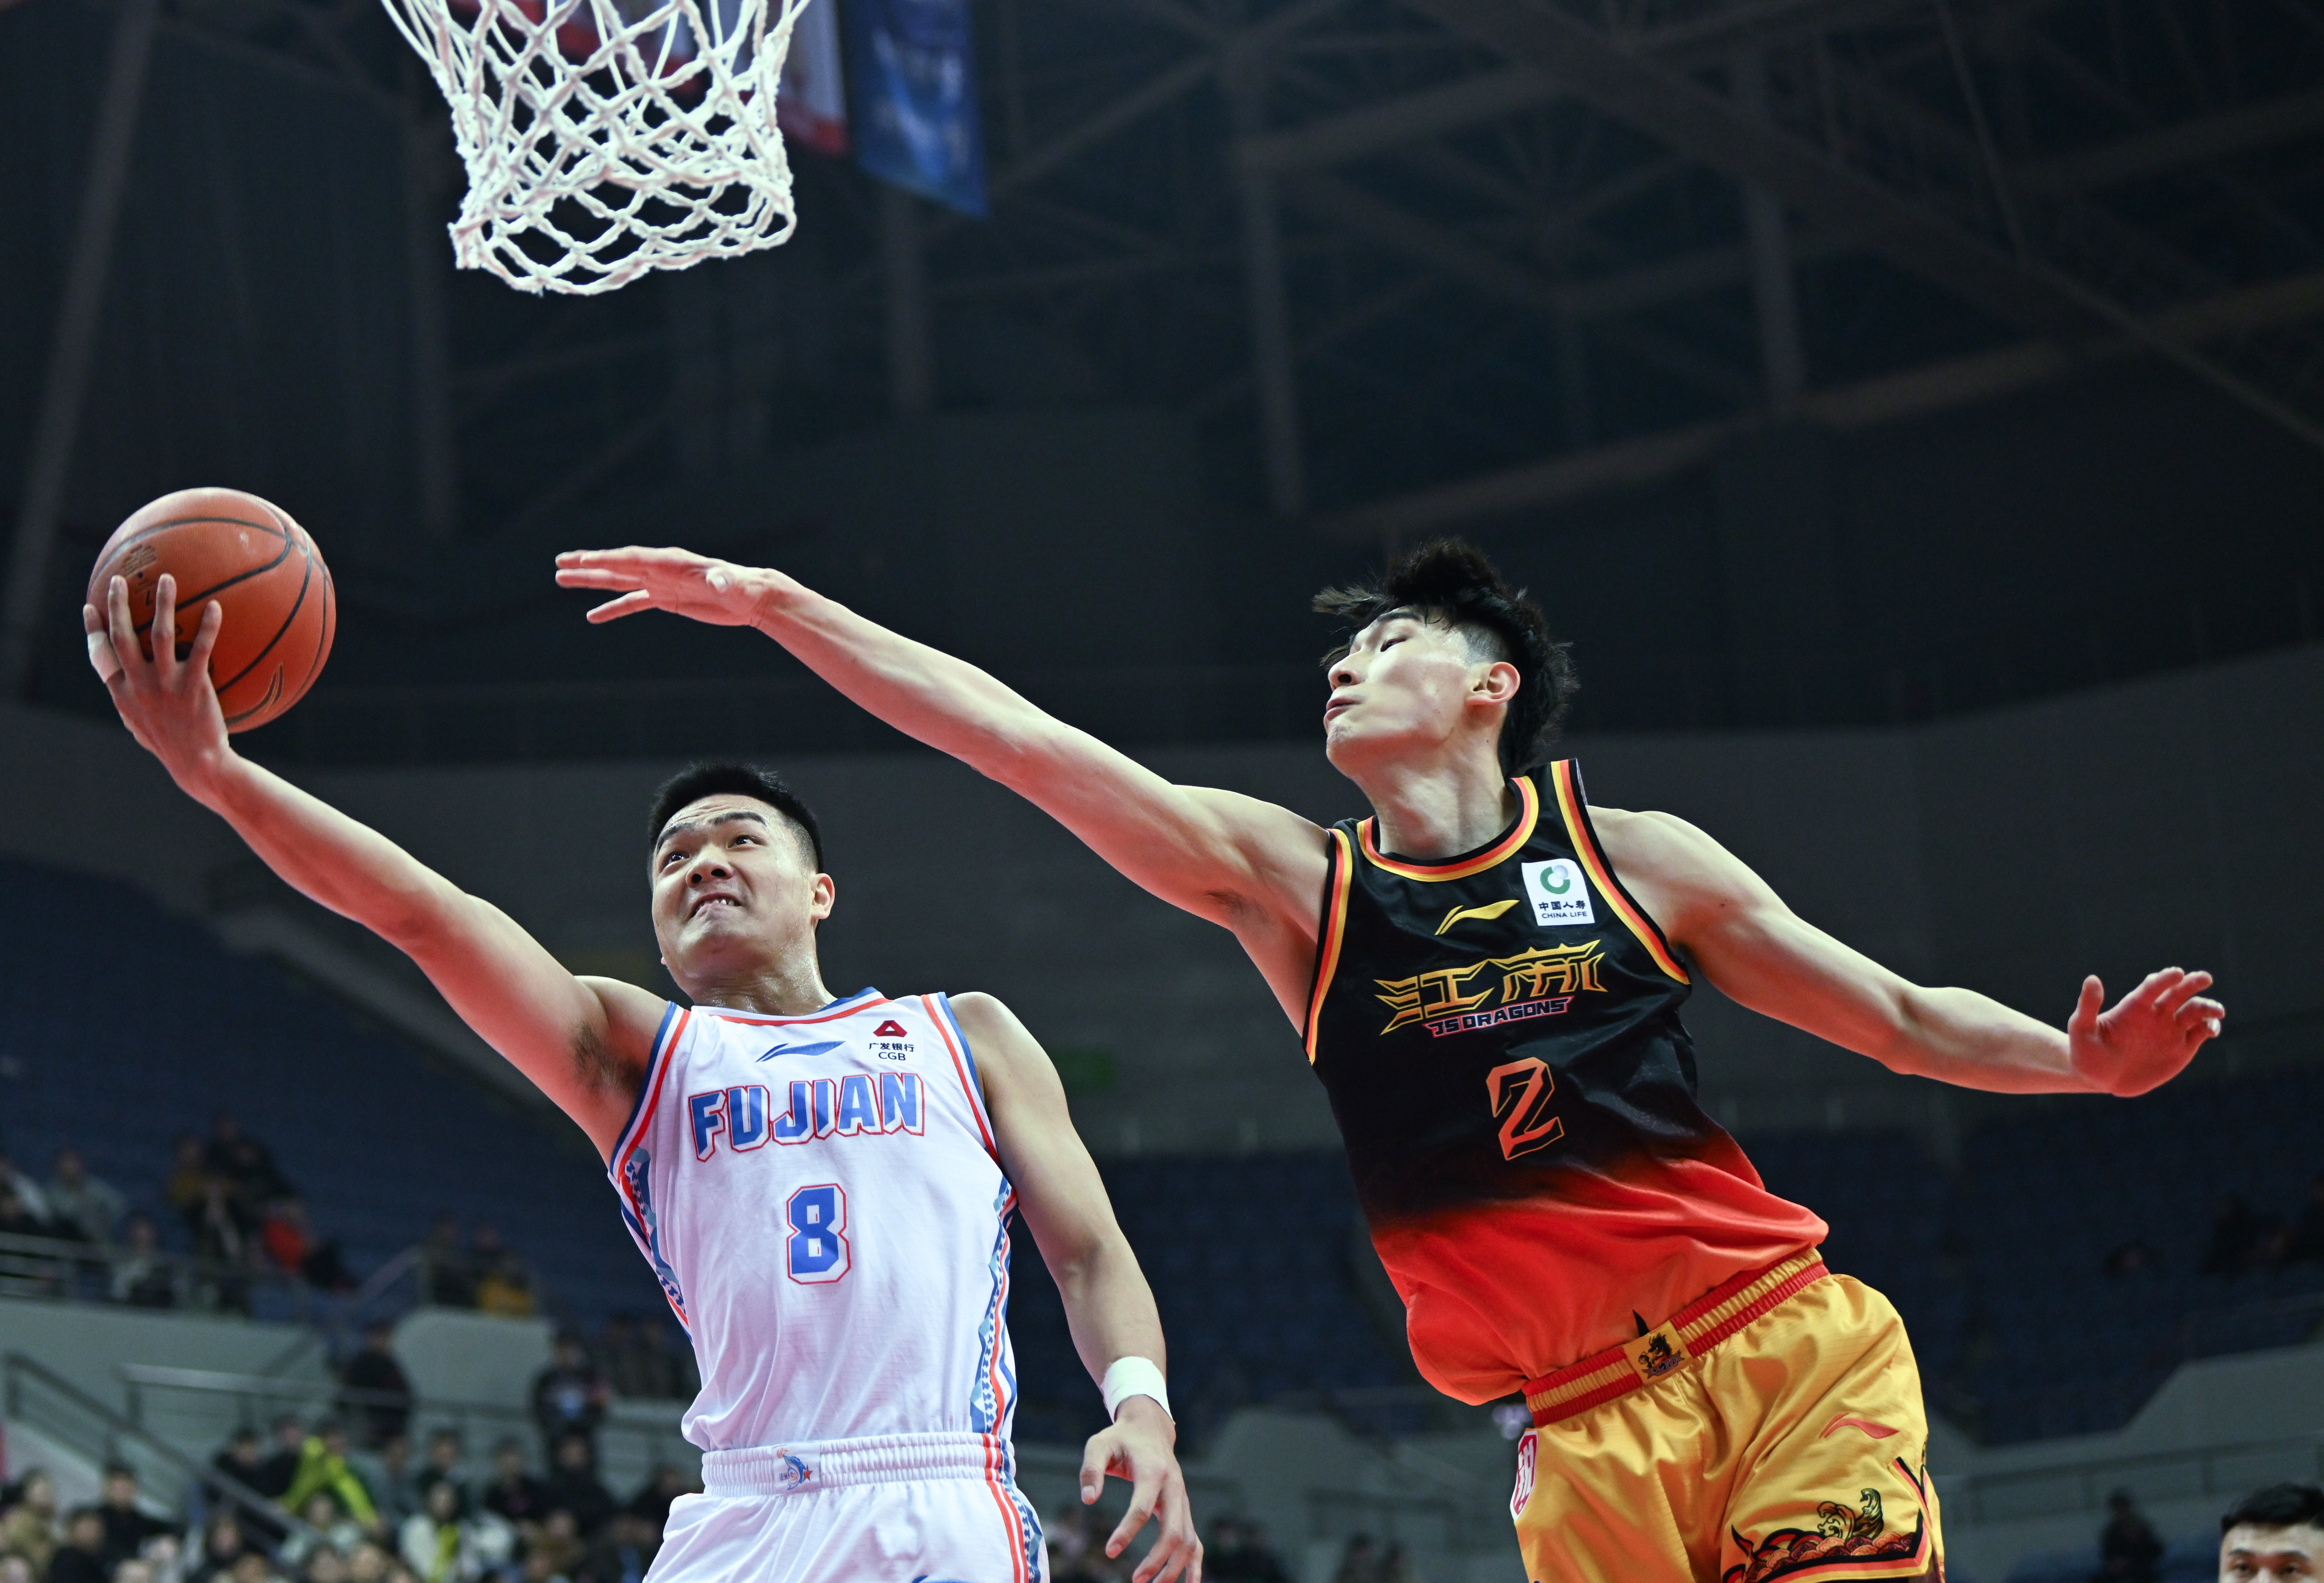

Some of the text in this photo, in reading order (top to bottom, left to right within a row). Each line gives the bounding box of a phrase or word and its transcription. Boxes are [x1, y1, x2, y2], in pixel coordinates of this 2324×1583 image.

[1538, 900, 1586, 911] 中国人寿
[1425, 997, 1571, 1037] JS DRAGONS
[869, 1043, 915, 1052] 广发银行
[878, 1052, 906, 1061] CGB
[688, 1073, 925, 1163] FUJIAN
[1486, 1057, 1565, 1161] 2
[786, 1183, 851, 1285] 8
